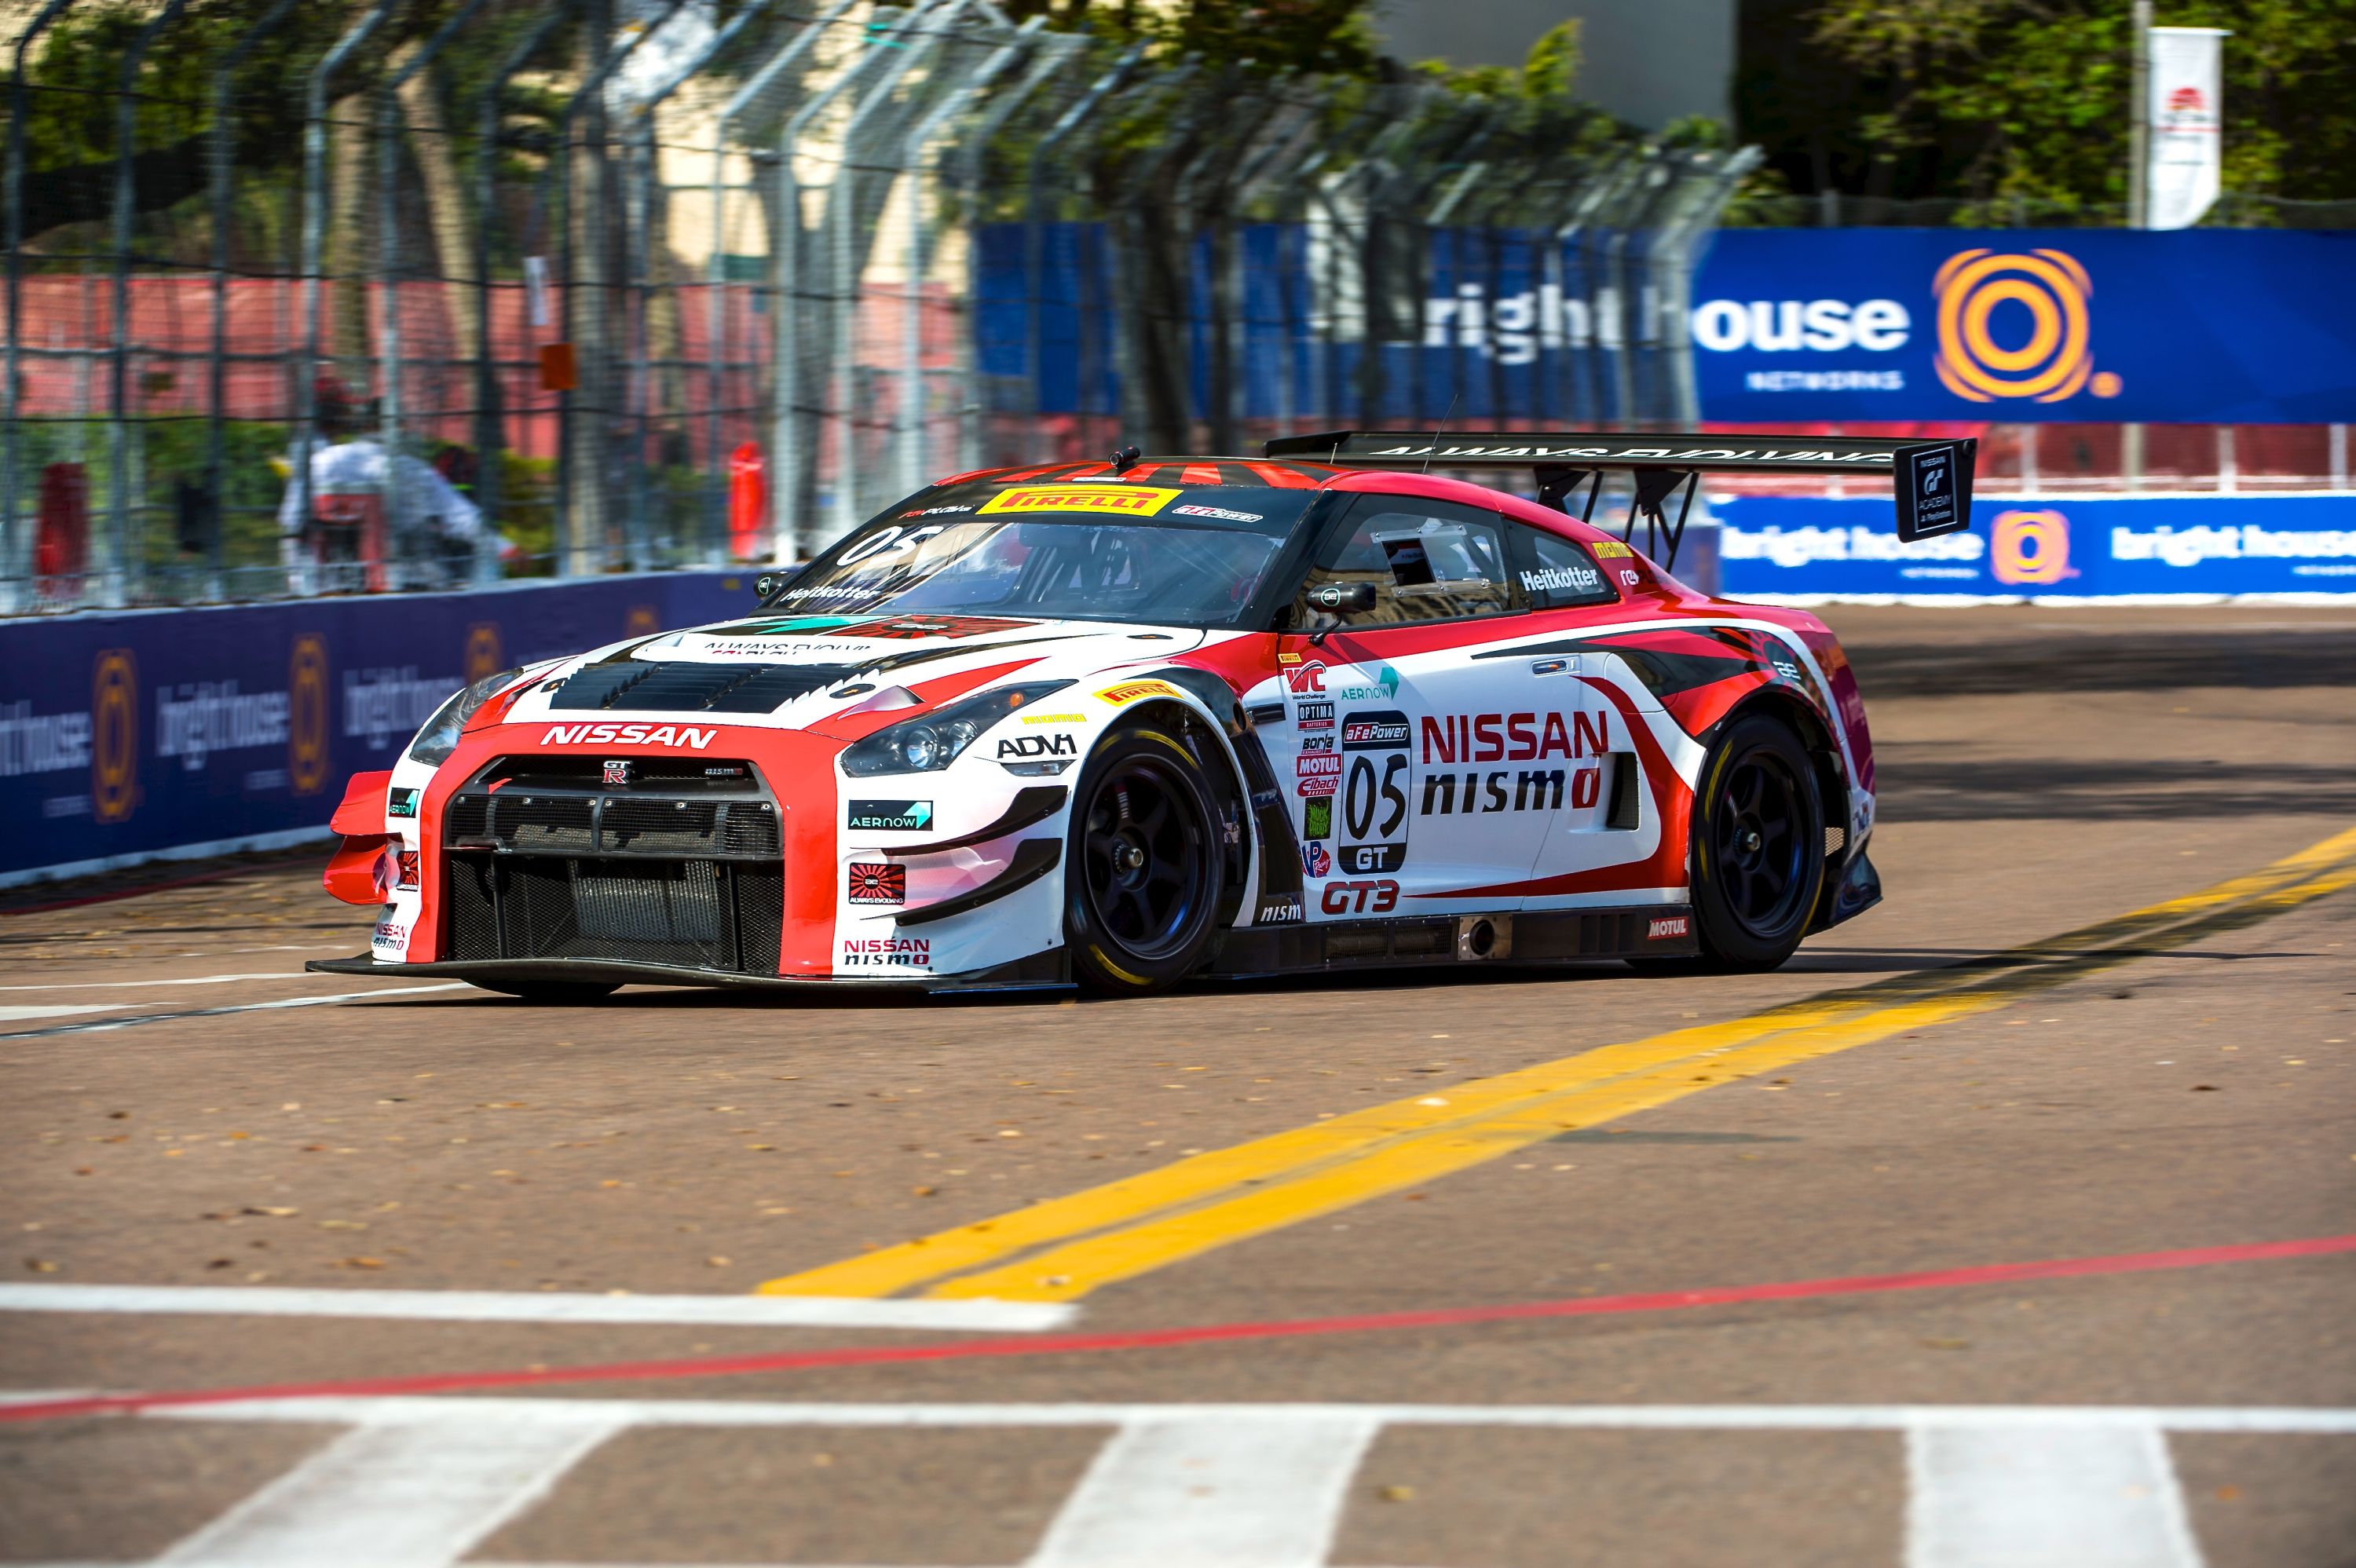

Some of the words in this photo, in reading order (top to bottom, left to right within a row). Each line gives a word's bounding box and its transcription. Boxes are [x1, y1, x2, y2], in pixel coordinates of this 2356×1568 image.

[998, 491, 1159, 510] PIRELLI
[836, 525, 944, 566] 05
[1520, 567, 1598, 591] Heitkotter
[1103, 683, 1174, 702] PIRELLI
[1300, 705, 1333, 719] OPTIMA
[540, 724, 718, 749] NISSAN
[1421, 711, 1608, 765] NISSAN
[1299, 758, 1340, 773] MOTUL
[1297, 776, 1339, 796] Eibach
[1345, 754, 1408, 841] 05
[1421, 767, 1601, 815] nismo
[1356, 847, 1388, 870] GT
[1321, 879, 1400, 916] GT3
[1649, 919, 1686, 938] MOTUL
[844, 938, 930, 952] NISSAN
